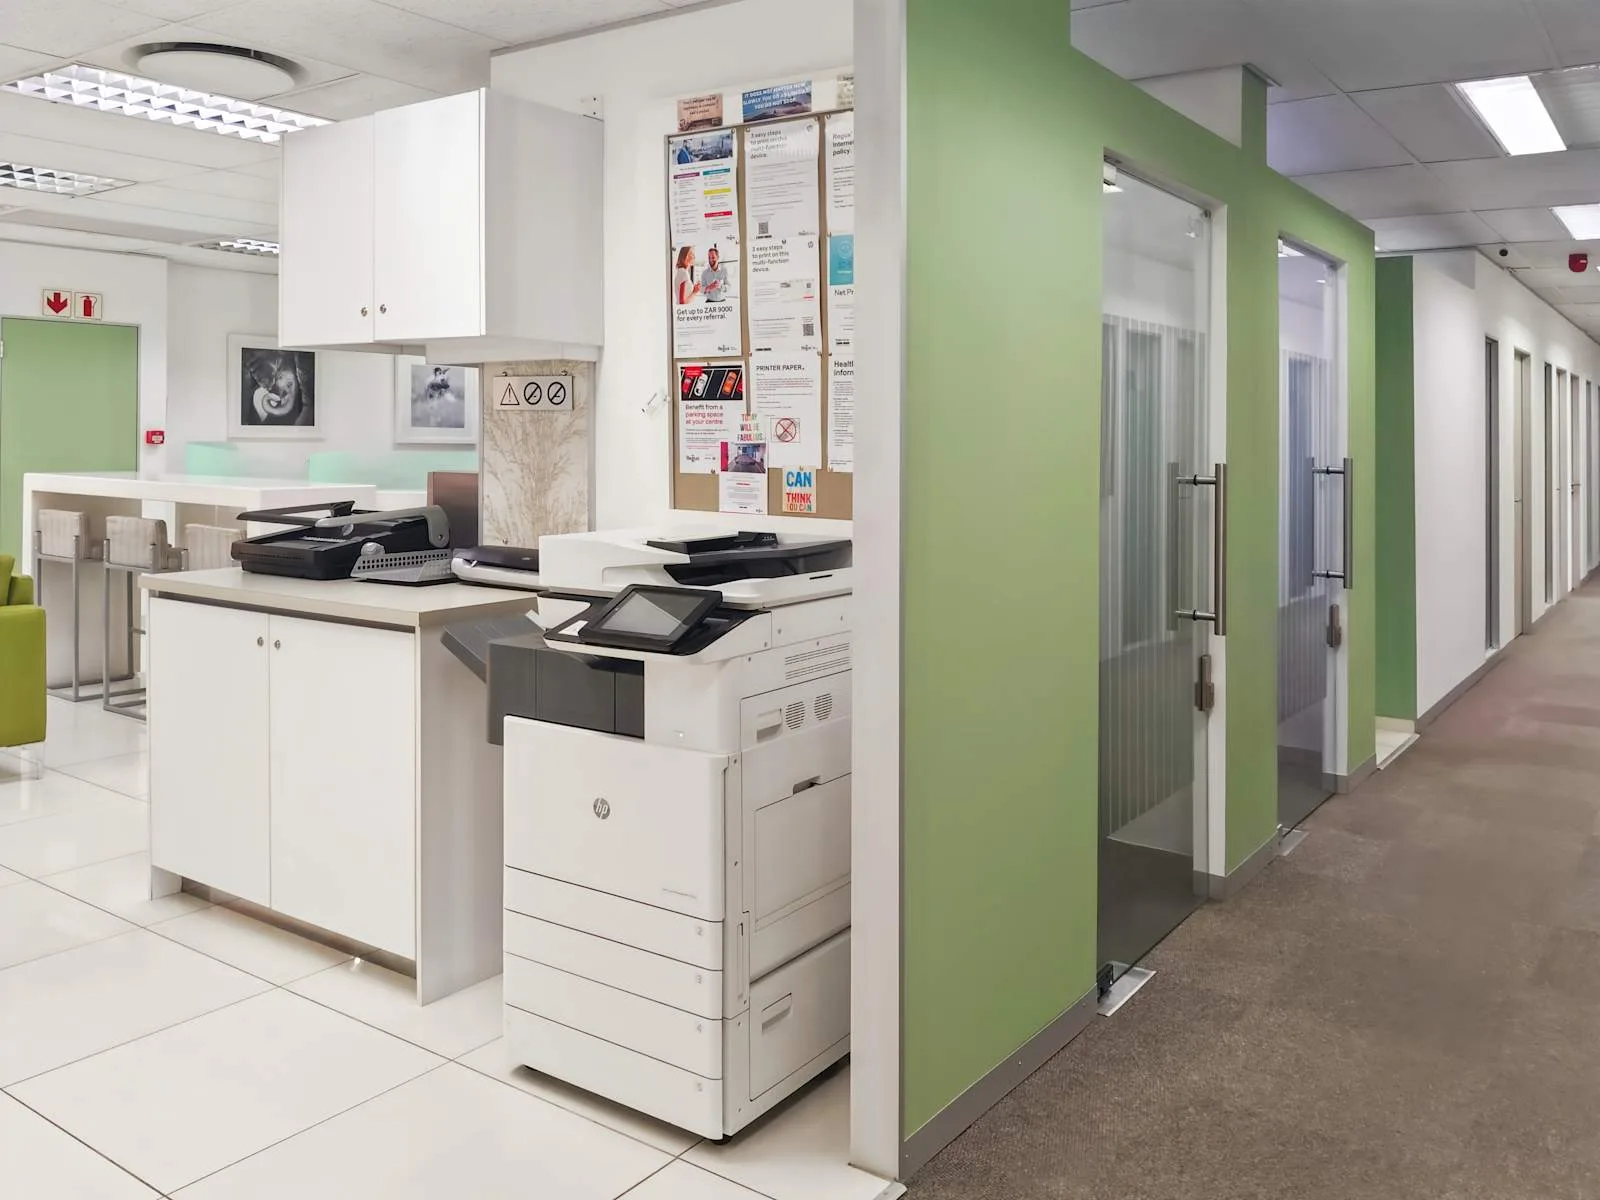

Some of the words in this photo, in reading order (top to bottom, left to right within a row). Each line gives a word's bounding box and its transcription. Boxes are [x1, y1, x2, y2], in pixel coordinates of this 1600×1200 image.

[832, 148, 850, 157] policy
[758, 252, 770, 260] print
[834, 288, 846, 296] Net
[688, 308, 696, 316] up
[786, 471, 812, 488] CAN
[786, 492, 812, 504] THINK
[798, 504, 812, 512] CAN
[594, 798, 610, 819] hp
